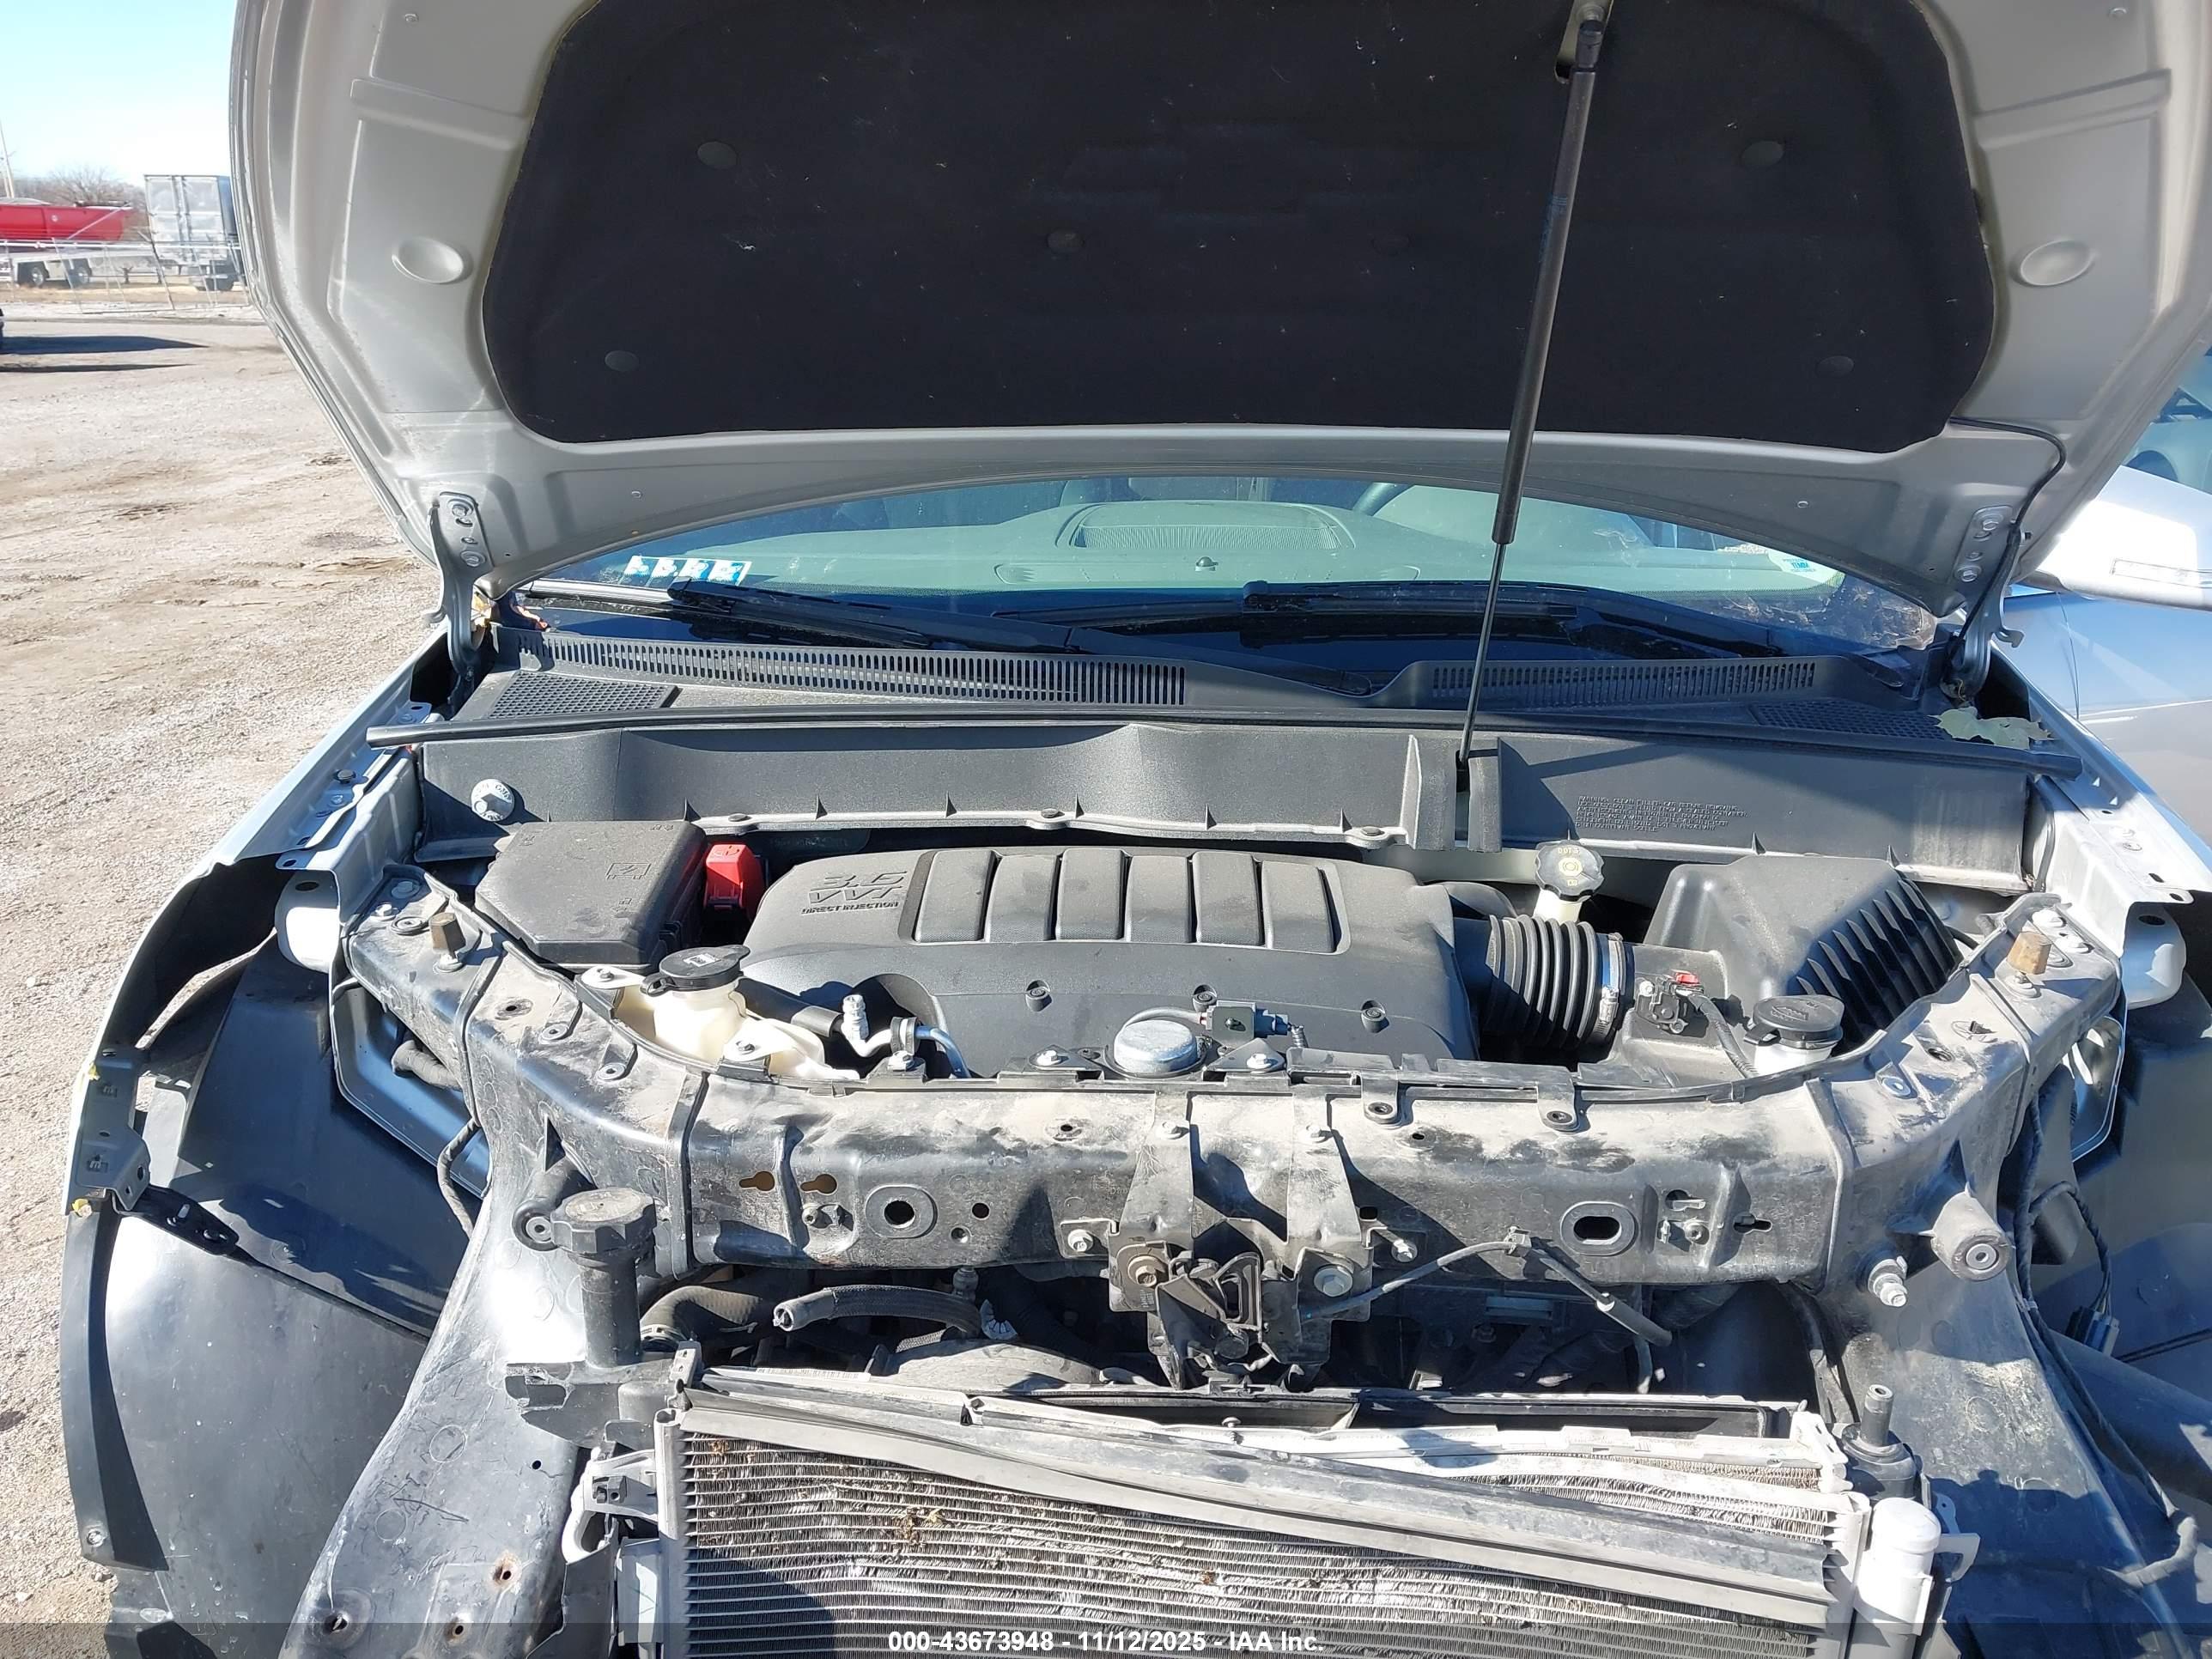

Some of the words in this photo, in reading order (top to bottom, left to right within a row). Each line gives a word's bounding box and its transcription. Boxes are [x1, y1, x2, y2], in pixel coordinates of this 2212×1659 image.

[811, 871, 908, 891] 3.6
[808, 885, 903, 904] VVT
[801, 905, 842, 915] DIRECT
[842, 901, 899, 911] INJECTION
